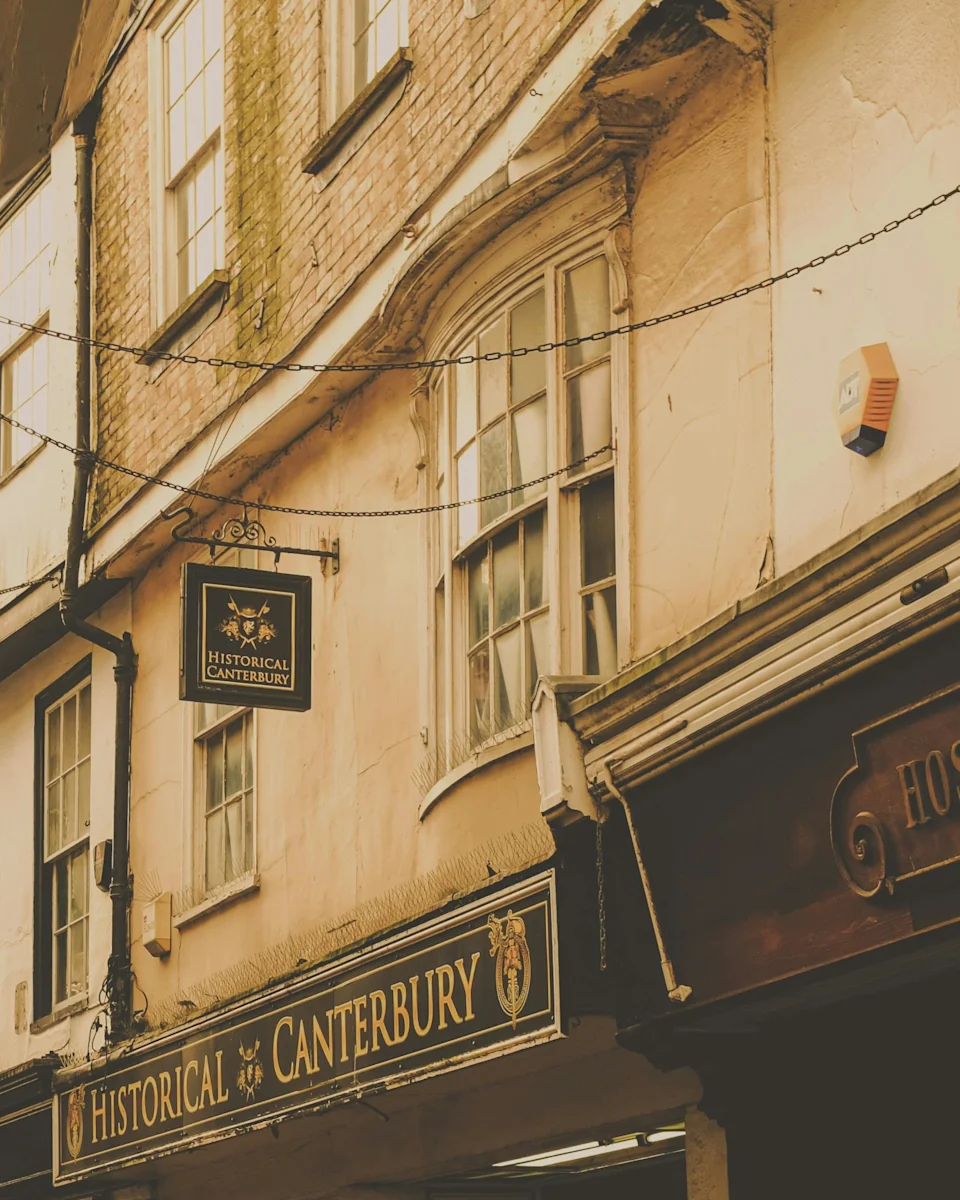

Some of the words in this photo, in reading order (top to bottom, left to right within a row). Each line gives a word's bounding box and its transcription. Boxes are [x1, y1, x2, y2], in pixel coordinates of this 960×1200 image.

[208, 651, 289, 671] HISTORICAL
[207, 666, 290, 685] CANTERBURY
[90, 1050, 229, 1144] HISTORICAL
[273, 952, 481, 1085] CANTERBURY
